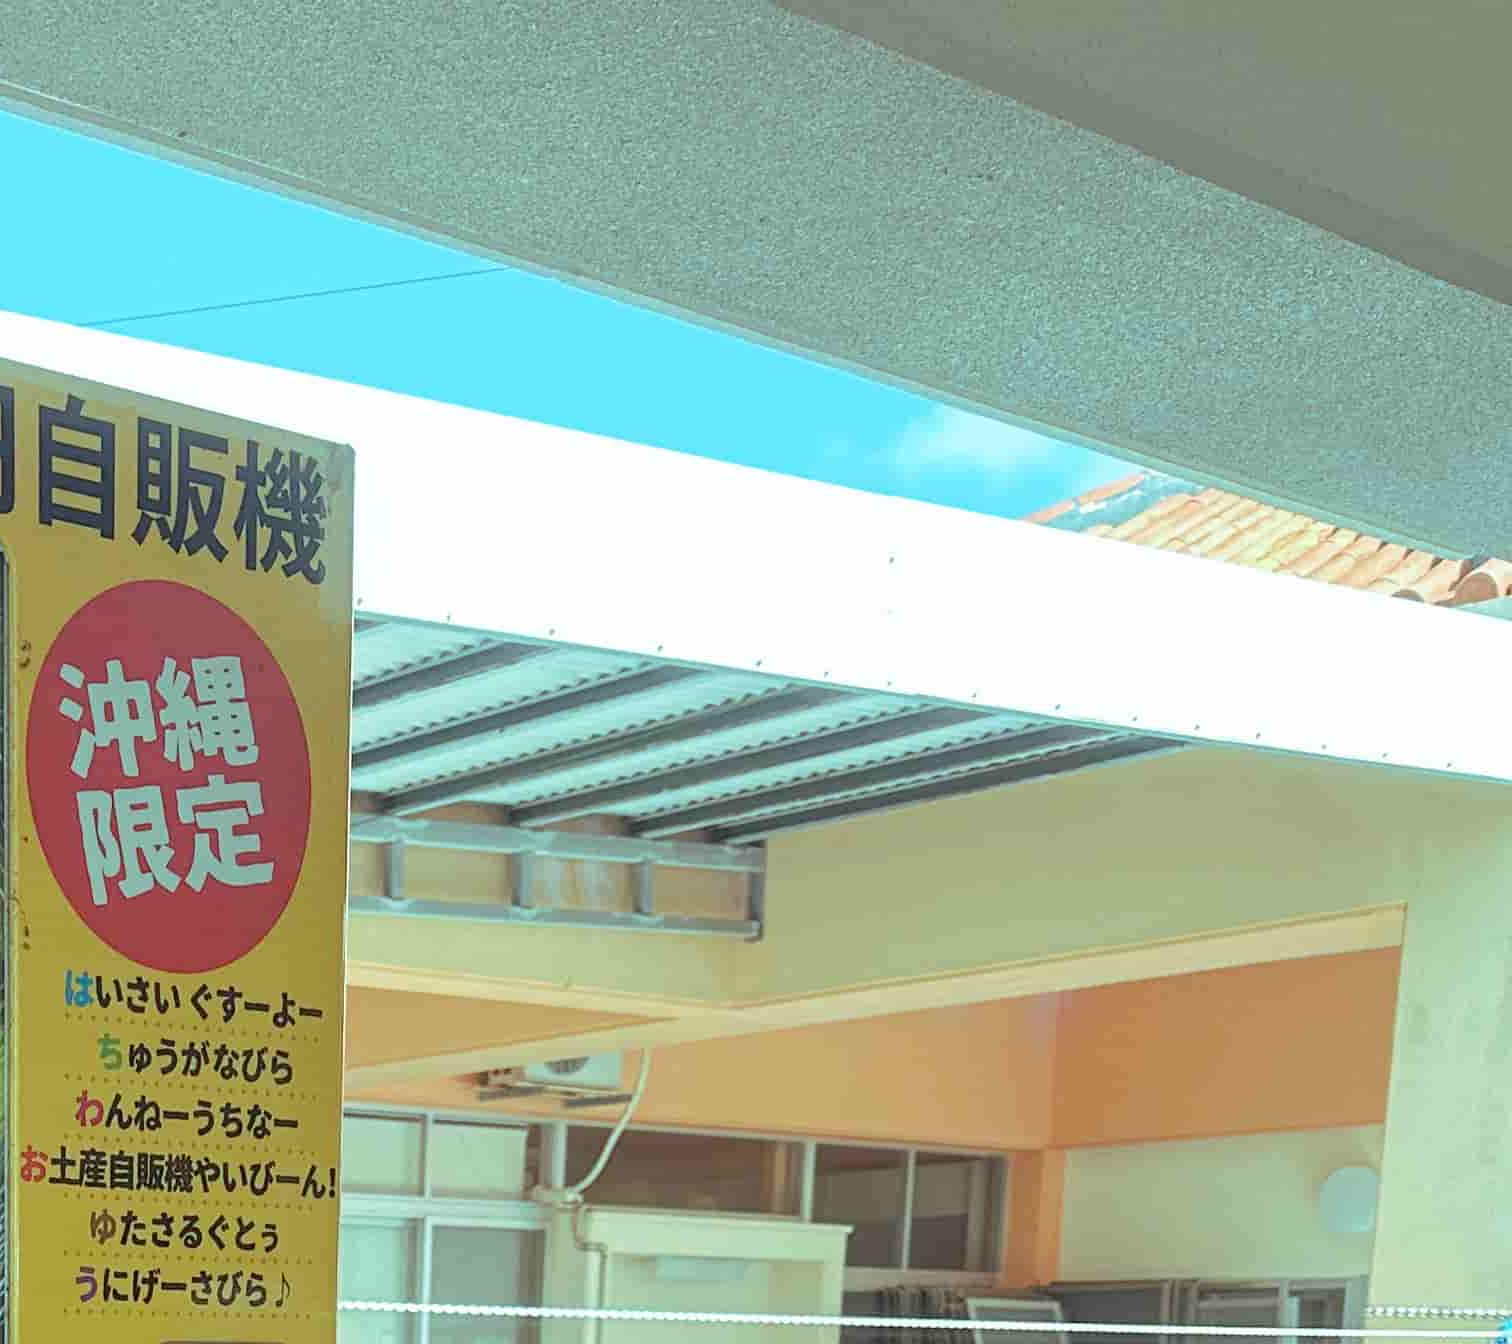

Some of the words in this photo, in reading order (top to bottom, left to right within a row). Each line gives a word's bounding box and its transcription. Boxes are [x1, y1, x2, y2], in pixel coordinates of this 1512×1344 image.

[59, 655, 260, 779] 沖縄
[75, 774, 274, 906] 限定
[74, 1089, 299, 1140] わんねーうちなー
